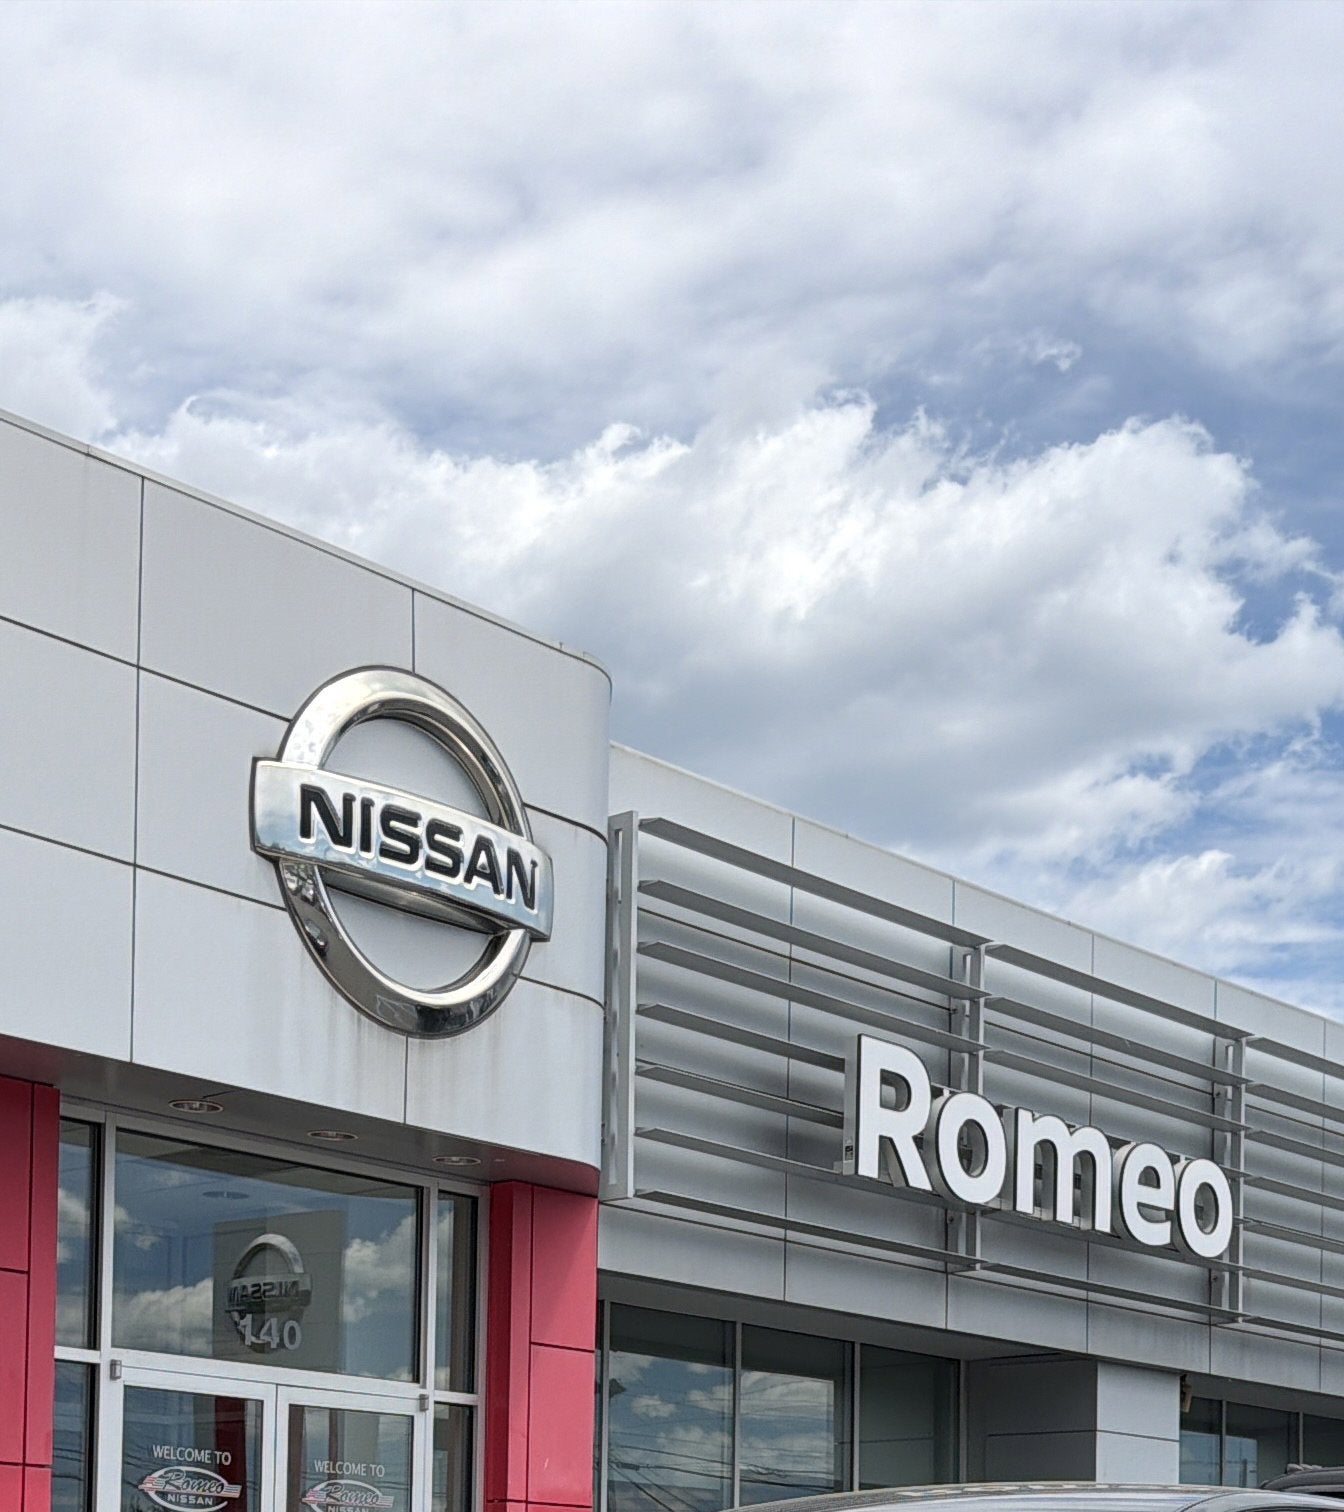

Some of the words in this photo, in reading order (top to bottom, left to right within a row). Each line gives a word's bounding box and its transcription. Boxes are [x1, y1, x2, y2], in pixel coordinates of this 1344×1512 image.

[298, 783, 540, 913] NISSAN
[856, 1033, 1233, 1258] Romeo
[238, 1313, 302, 1350] 140
[152, 1444, 212, 1463] WELCOME
[214, 1450, 232, 1466] TO
[313, 1459, 367, 1476] WELCOME
[369, 1463, 385, 1477] TO
[161, 1469, 225, 1494] Romeo
[325, 1482, 381, 1505] Romeo
[167, 1493, 213, 1506] NISSAN
